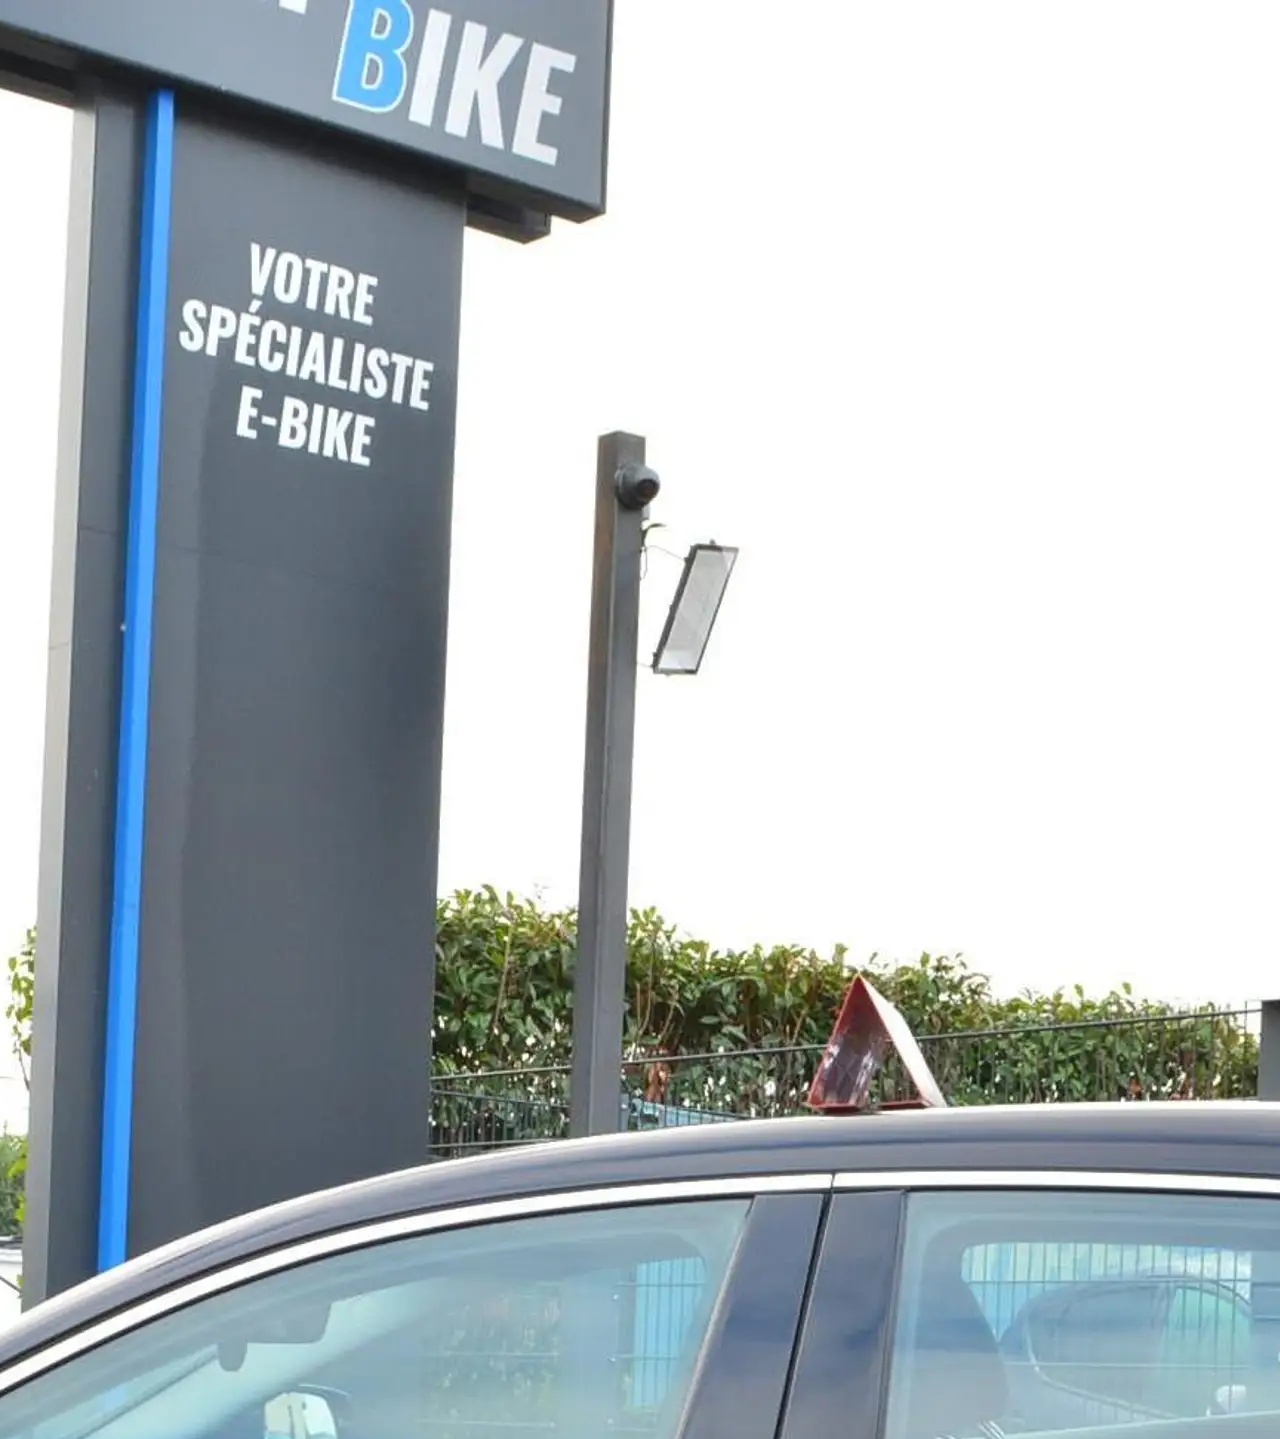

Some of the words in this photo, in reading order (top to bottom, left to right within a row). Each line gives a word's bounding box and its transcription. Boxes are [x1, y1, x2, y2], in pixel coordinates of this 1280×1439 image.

[332, 0, 577, 166] BIKE
[250, 242, 378, 326] VOTRE
[179, 299, 435, 411] SPÉCIALISTE
[236, 386, 375, 467] E-BIKE
